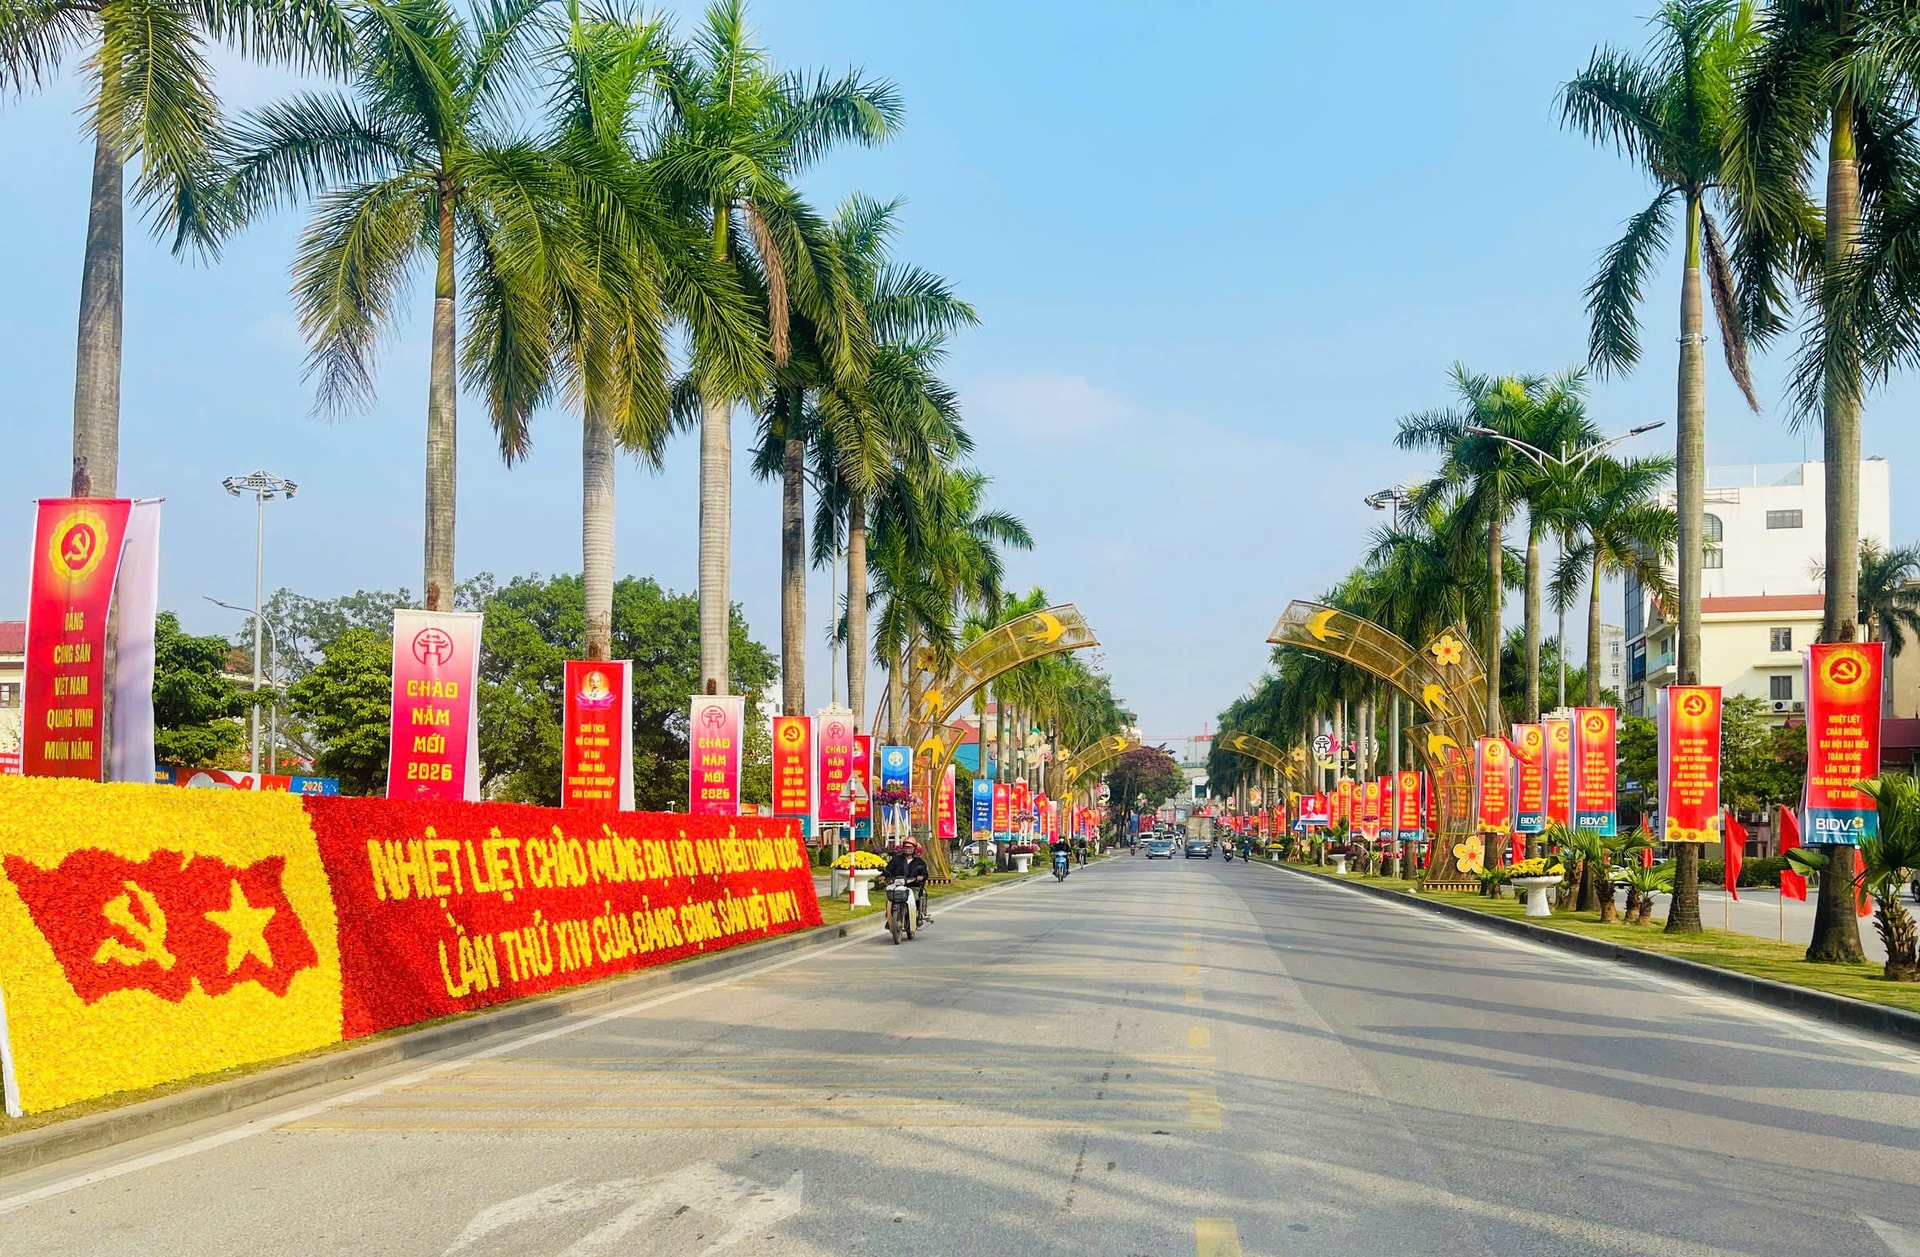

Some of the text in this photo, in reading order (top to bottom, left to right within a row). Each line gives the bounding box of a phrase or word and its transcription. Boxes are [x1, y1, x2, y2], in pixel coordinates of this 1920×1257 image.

[75, 637, 91, 663] SẢN
[70, 676, 88, 695] NAM
[407, 677, 458, 698] CHÀO
[74, 708, 94, 727] VINH
[411, 704, 450, 726] NĂM
[413, 733, 445, 754] MỚI
[407, 762, 452, 781] 2026
[301, 781, 323, 793] 2026
[701, 788, 730, 799] 2026
[1580, 817, 1601, 825] BIDV
[1815, 818, 1852, 831] BIDV
[367, 823, 802, 908] NHIỆT LIỆT CHÀO MỪNG ĐẠI HỘI ĐẠI BIỂU TOÀN QUỐC
[438, 912, 500, 997] LẦN
[499, 909, 552, 982] THỨ
[553, 919, 593, 974] XIV
[593, 900, 637, 963] CỦA
[632, 895, 683, 953] ĐẢNG
[680, 896, 722, 950] CỘNG
[717, 887, 748, 935] SẢN
[742, 887, 769, 934] VIỆT
